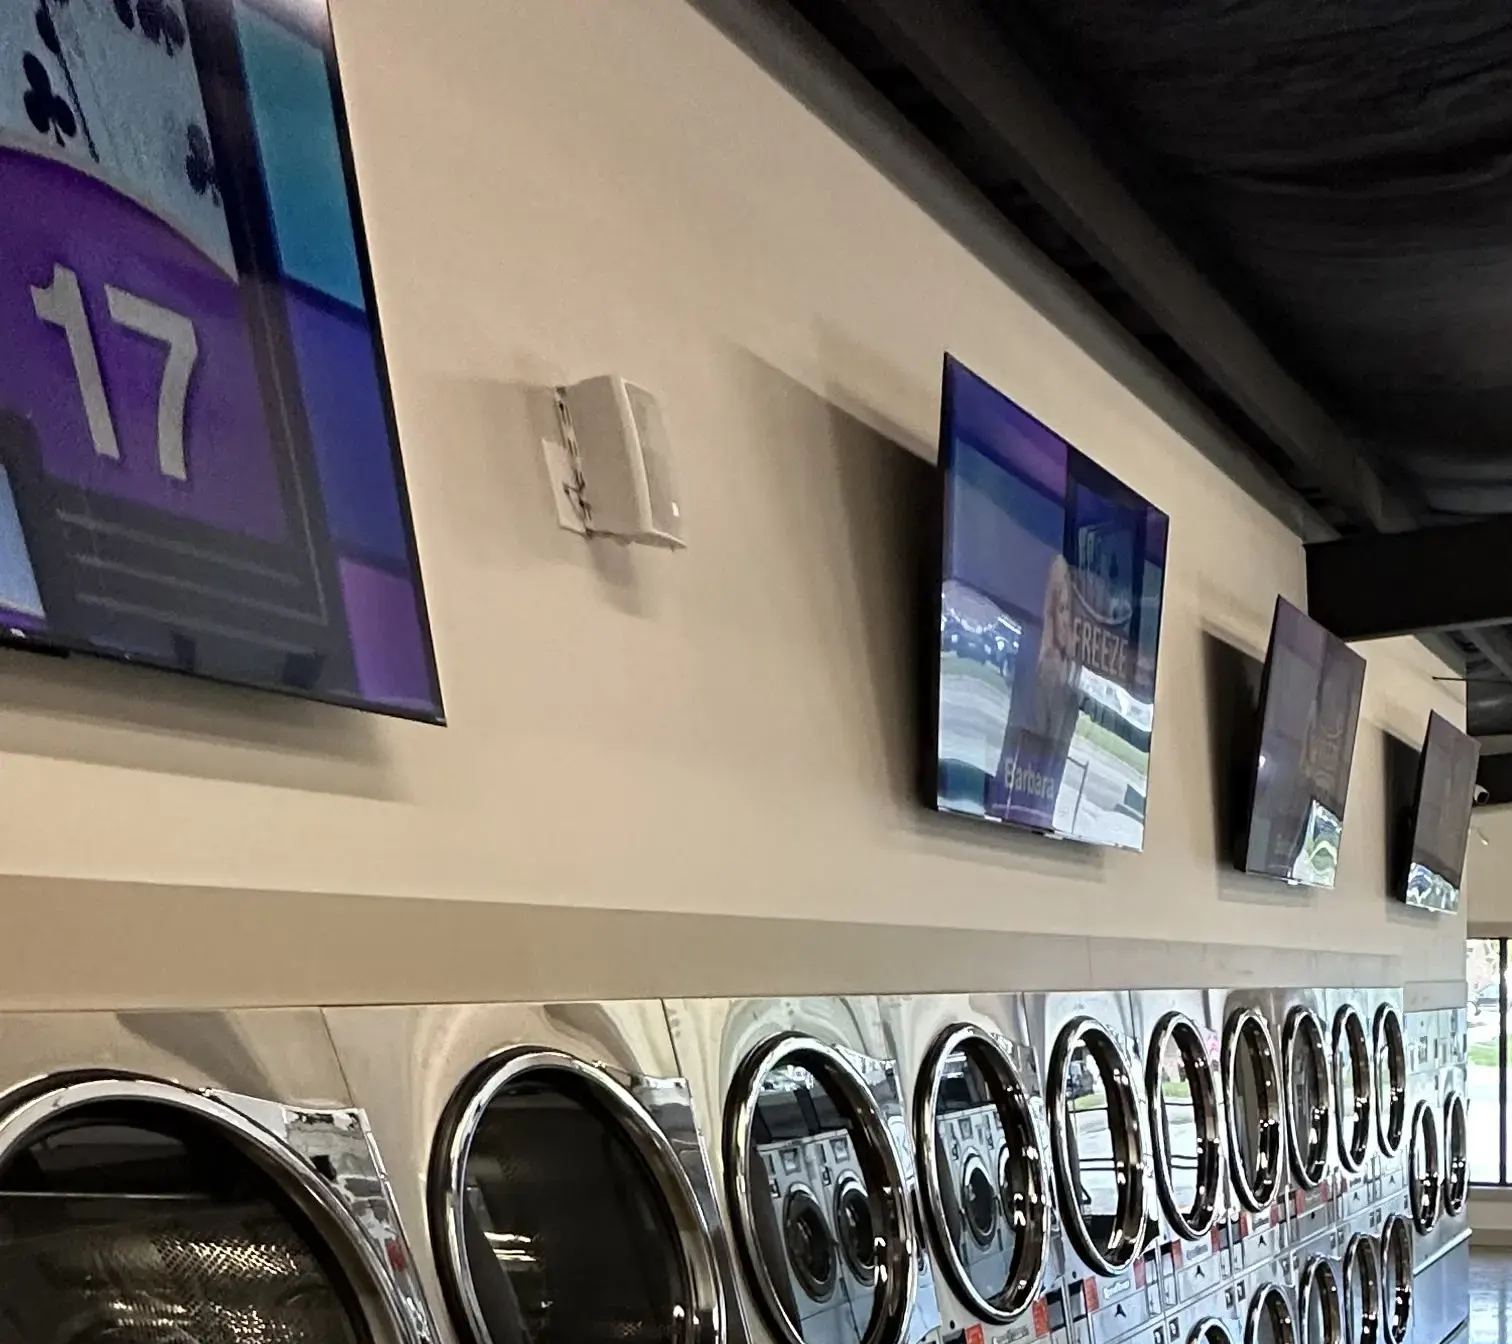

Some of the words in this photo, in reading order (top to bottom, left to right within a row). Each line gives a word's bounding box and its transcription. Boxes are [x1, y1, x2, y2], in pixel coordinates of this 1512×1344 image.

[30, 262, 199, 481] 17
[1073, 617, 1129, 678] FREEZE
[1004, 758, 1055, 798] Barbara
